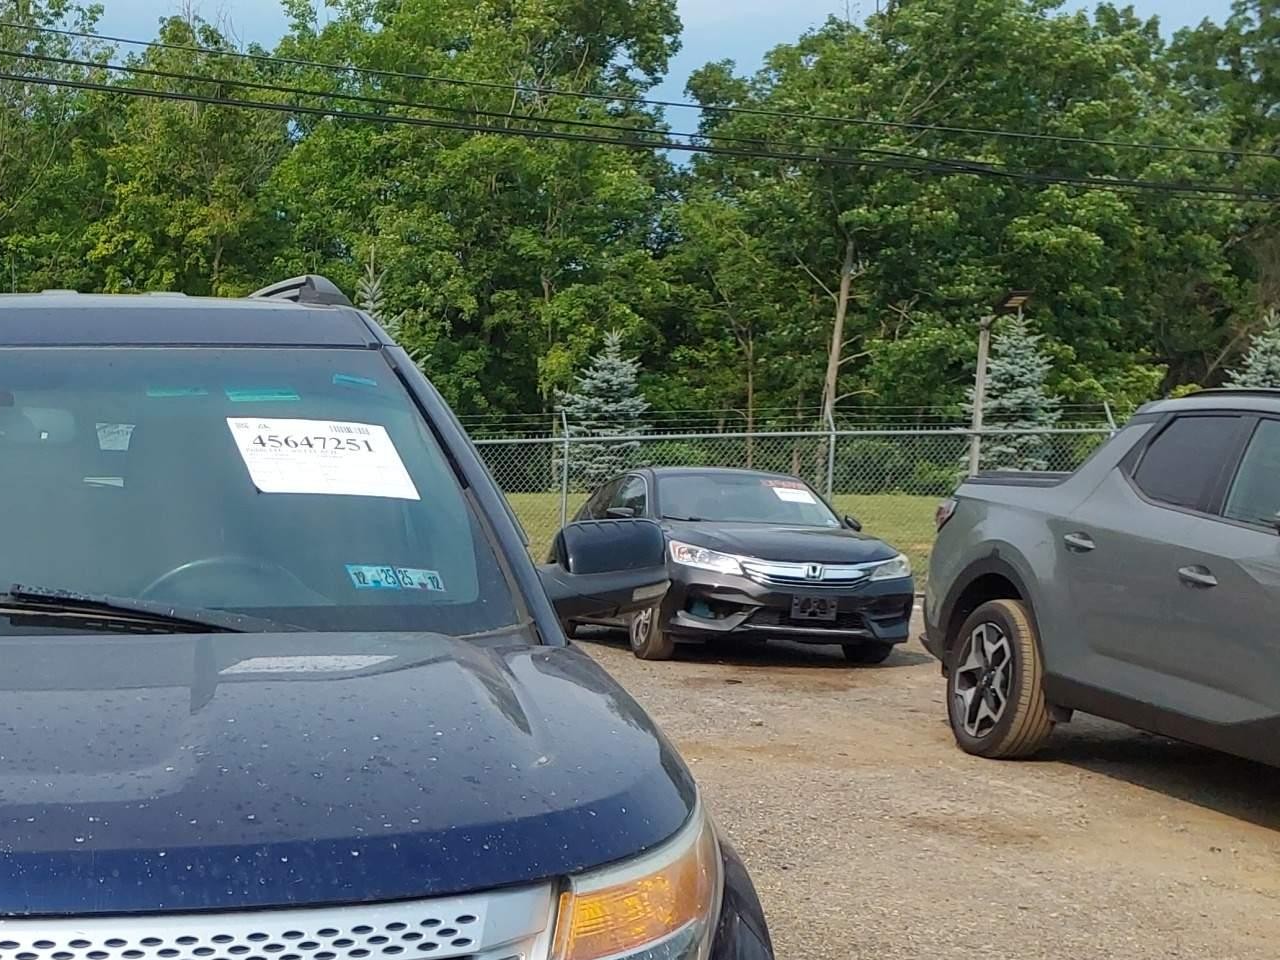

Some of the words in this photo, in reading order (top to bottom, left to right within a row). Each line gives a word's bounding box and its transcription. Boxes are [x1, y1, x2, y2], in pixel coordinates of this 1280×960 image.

[252, 434, 375, 453] 45647251
[353, 570, 369, 585] 12
[381, 568, 397, 585] 25
[398, 569, 415, 586] 25
[428, 575, 443, 590] 12
